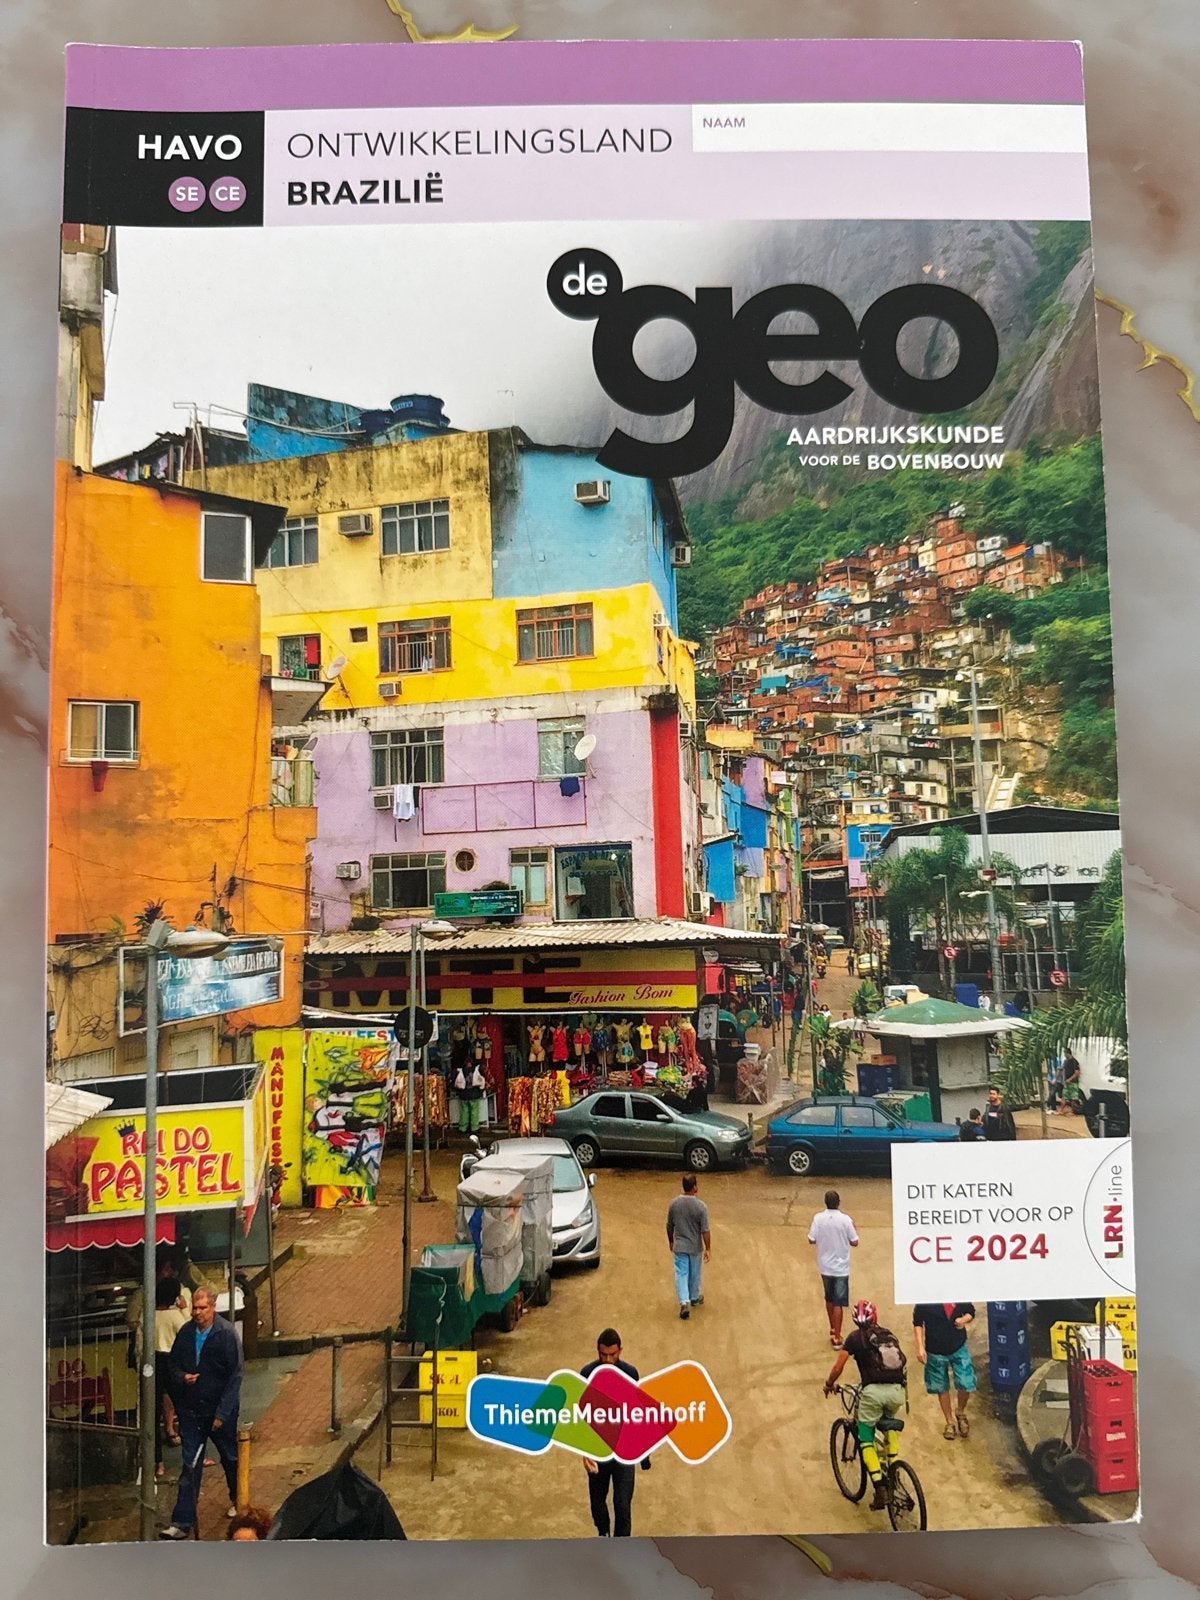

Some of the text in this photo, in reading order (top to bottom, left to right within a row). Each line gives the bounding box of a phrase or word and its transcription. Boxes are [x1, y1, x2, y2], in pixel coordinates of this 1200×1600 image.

[702, 116, 746, 128] NAAM
[137, 134, 243, 161] HAVO
[287, 127, 672, 158] ONTWIKKELINGSLAND
[175, 186, 199, 203] SE
[214, 186, 241, 203] CE
[287, 172, 445, 206] BRAZILIË
[561, 261, 608, 296] de
[592, 283, 999, 479] geo
[786, 425, 1005, 447] AARDRIJKSKUNDE
[799, 453, 1005, 471] VOOR DE BOVENBOUW
[568, 983, 673, 1005] Fashion Bom
[174, 1126, 211, 1153] DO
[91, 1152, 241, 1203] PASTEL
[907, 1182, 1013, 1200] DIT KATERN
[908, 1206, 1073, 1225] BEREIDT VOOR OP
[909, 1233, 1049, 1263] CE 2024
[484, 1401, 706, 1426] ThiemeMeulenhoff
